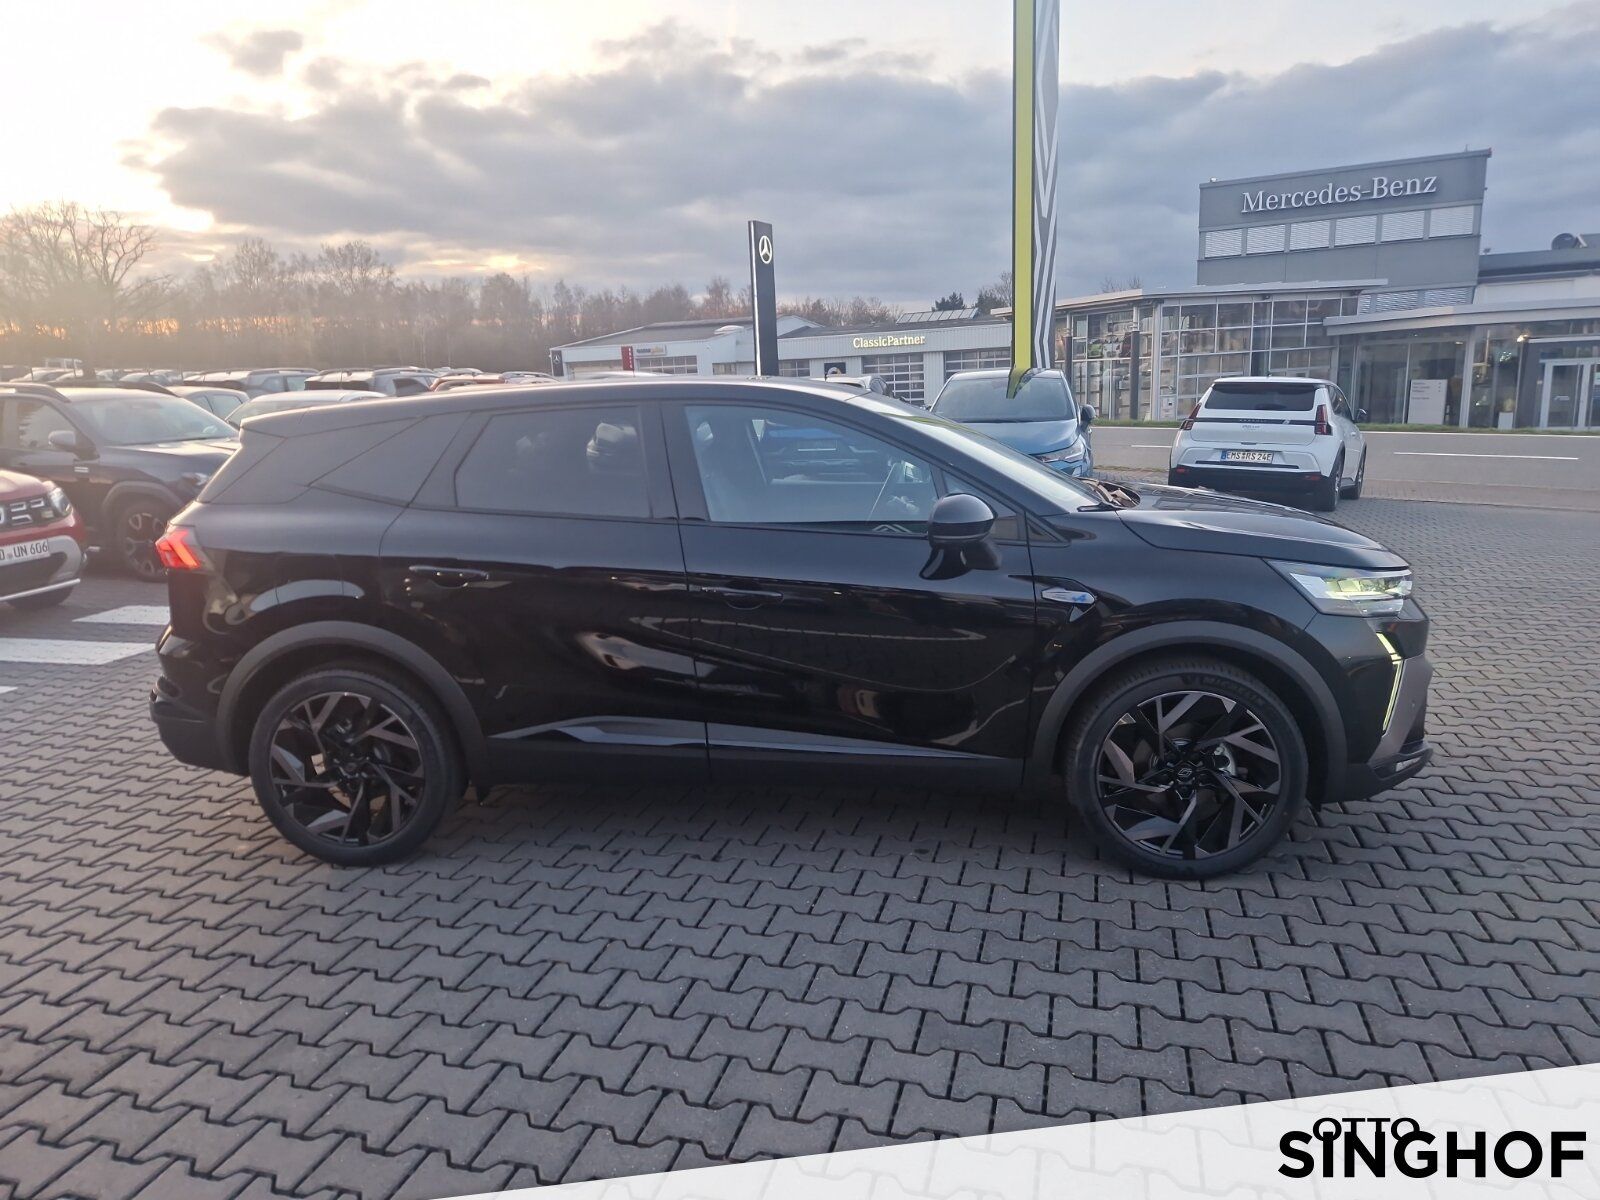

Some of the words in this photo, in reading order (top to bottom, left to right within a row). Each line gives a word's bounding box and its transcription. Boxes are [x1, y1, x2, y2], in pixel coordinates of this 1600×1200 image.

[1241, 176, 1437, 213] Mercedes-Benz
[853, 335, 926, 348] ClassicPartner
[1246, 451, 1256, 460] RS
[13, 545, 28, 558] UN
[30, 542, 48, 555] 606
